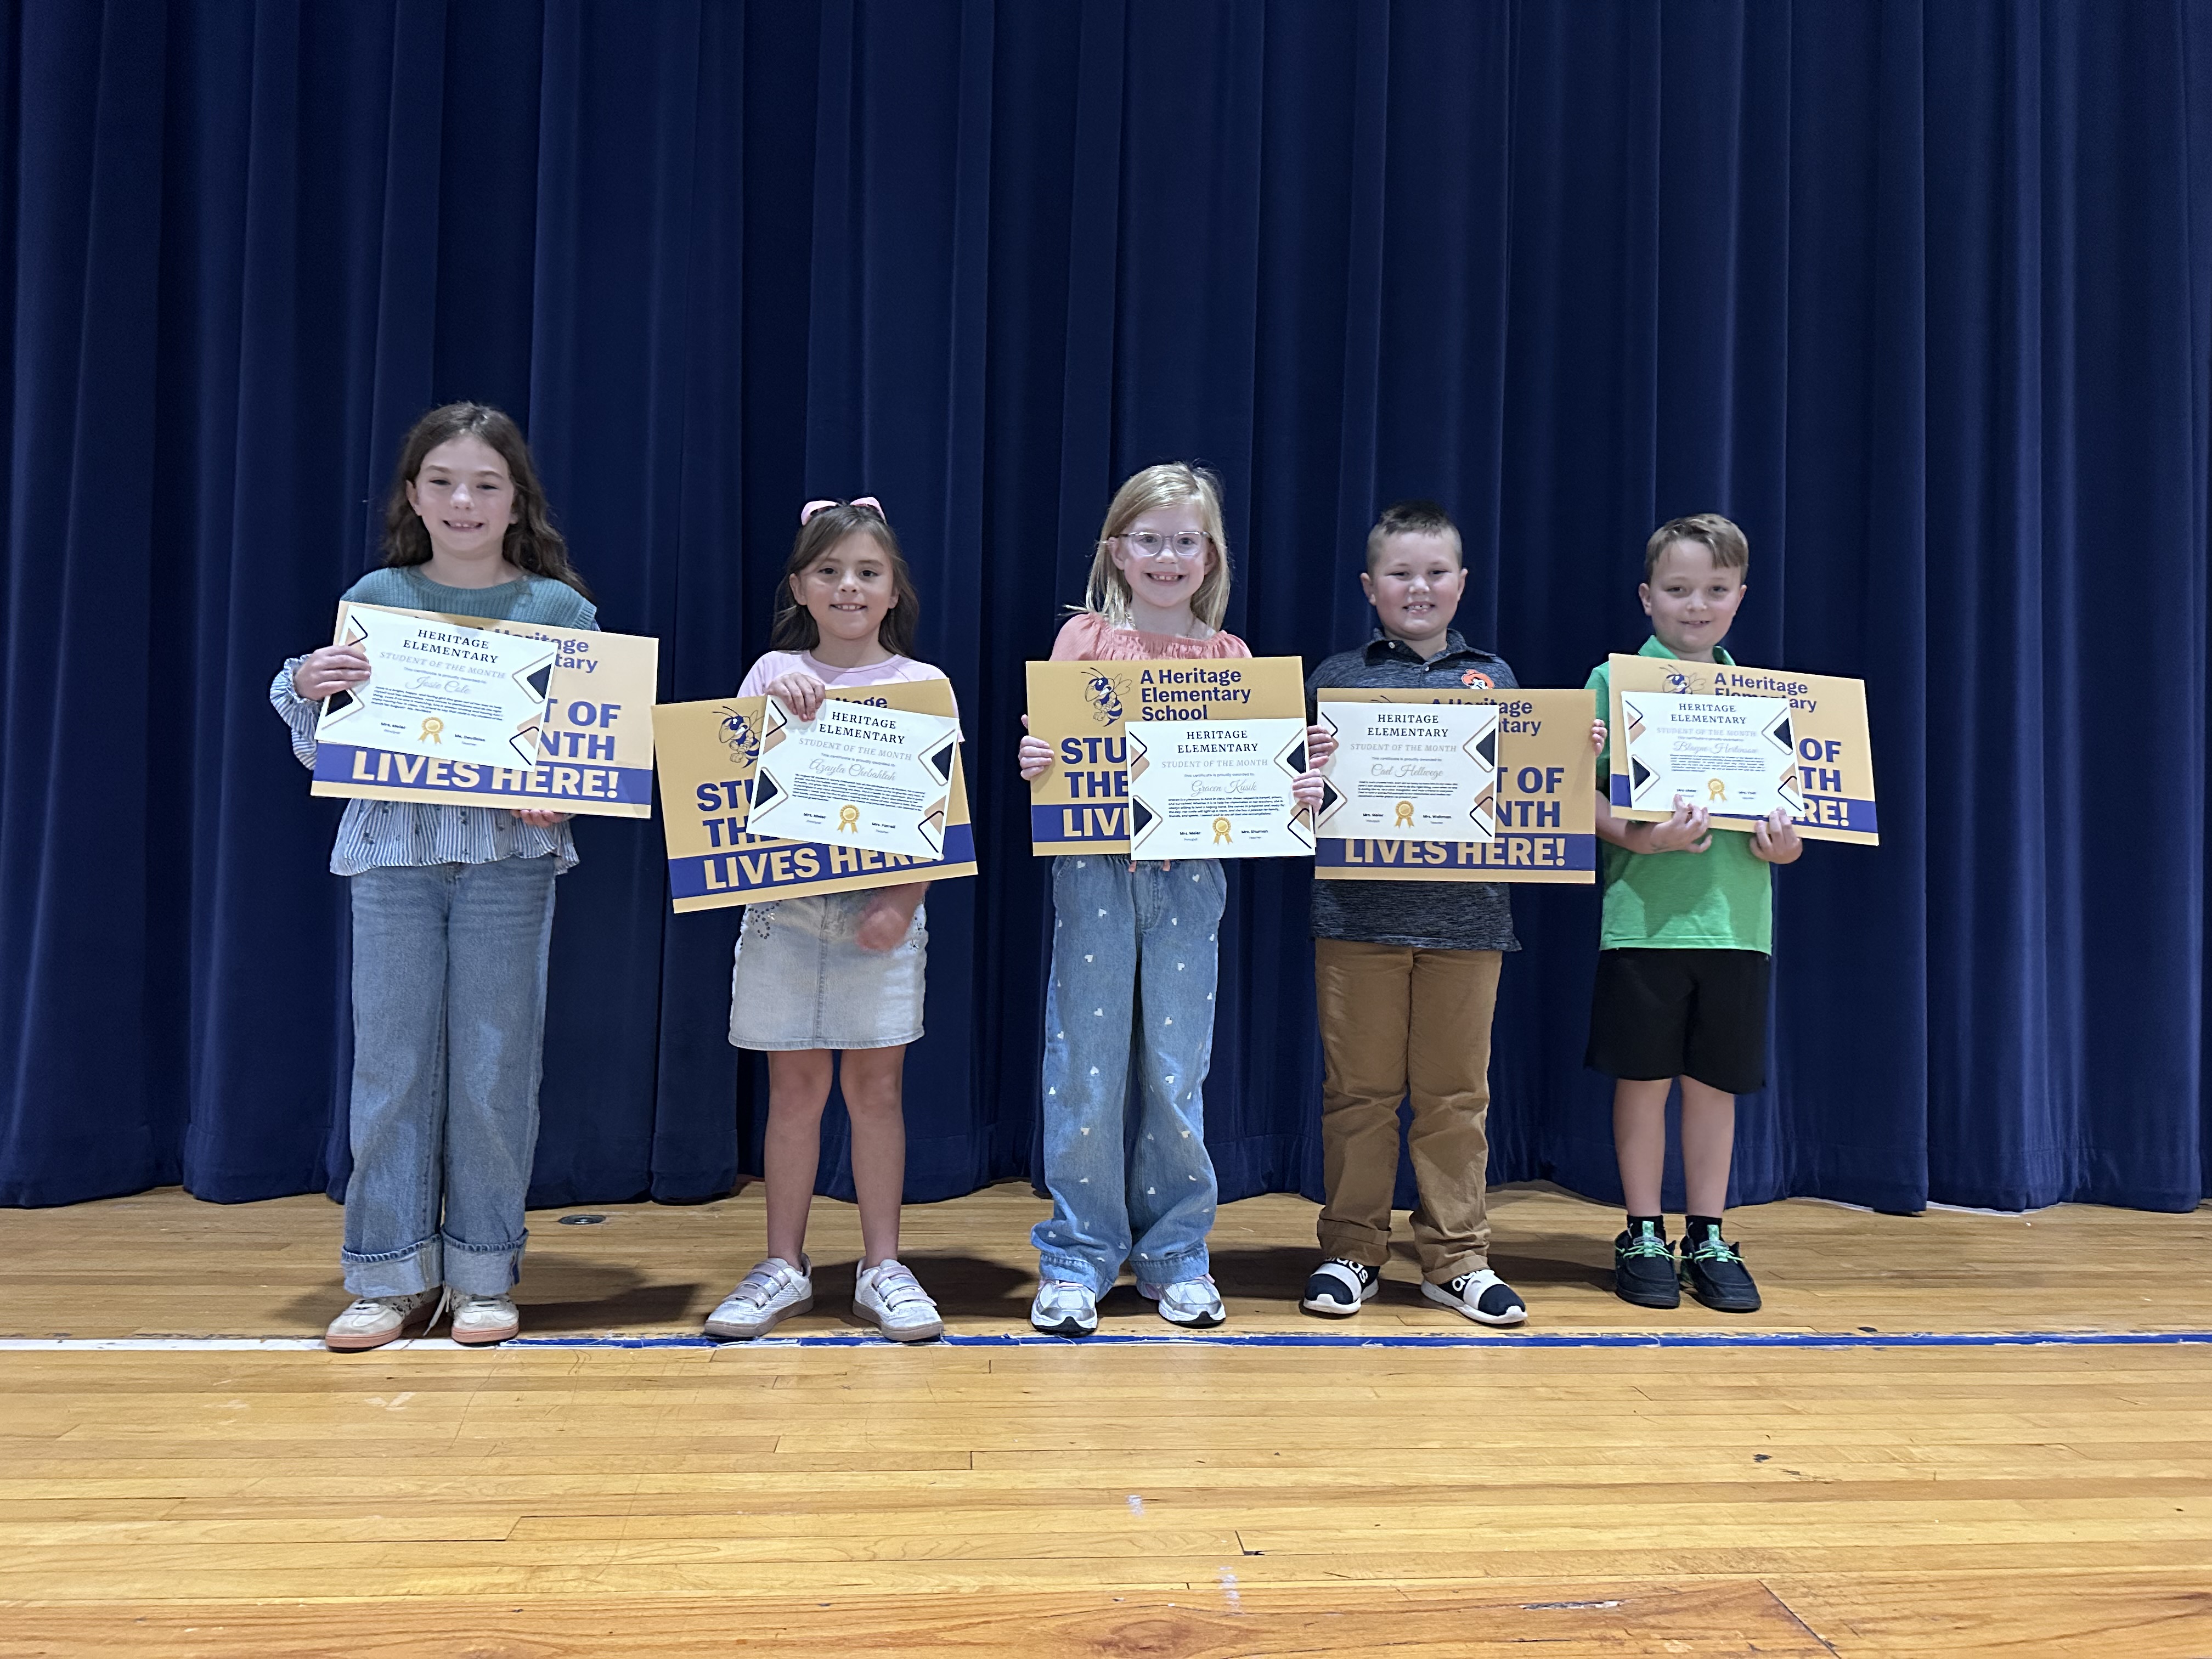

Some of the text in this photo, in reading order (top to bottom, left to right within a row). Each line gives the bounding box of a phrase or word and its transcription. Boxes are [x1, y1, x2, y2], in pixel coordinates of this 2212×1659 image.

[403, 639, 499, 663] ELEMENTARY
[417, 629, 489, 650] HERITAGE
[379, 651, 428, 665] STUDENT
[428, 660, 441, 668] OF
[445, 662, 466, 672] THE
[467, 665, 506, 679] MONTH
[1141, 667, 1242, 686] A Heritage
[1142, 687, 1251, 704] Elementary
[1714, 672, 1808, 696] A Heritage
[568, 701, 621, 728] OF
[1142, 704, 1208, 721] School
[1378, 714, 1439, 724] HERITAGE
[1671, 714, 1747, 724] ELEMENTARY
[1679, 703, 1737, 713] HERITAGE
[831, 712, 897, 729] HERITAGE
[1367, 727, 1449, 737] ELEMENTARY
[540, 731, 615, 761] NTH
[819, 724, 905, 744] ELEMENTARY
[1186, 730, 1248, 740] HERITAGE
[798, 737, 842, 750] STUDENT
[857, 746, 877, 755] THE
[878, 749, 912, 761] MONTH
[1177, 743, 1258, 753] ELEMENTARY
[1799, 738, 1842, 763] OF
[352, 751, 619, 799] LIVES HERE!
[1517, 766, 1564, 793] OF
[1063, 808, 1130, 837] LIV
[1496, 800, 1560, 827] NTH
[1794, 798, 1849, 827] RE!
[1345, 837, 1565, 866] LIVES HERE!
[704, 847, 820, 890] LIVES
